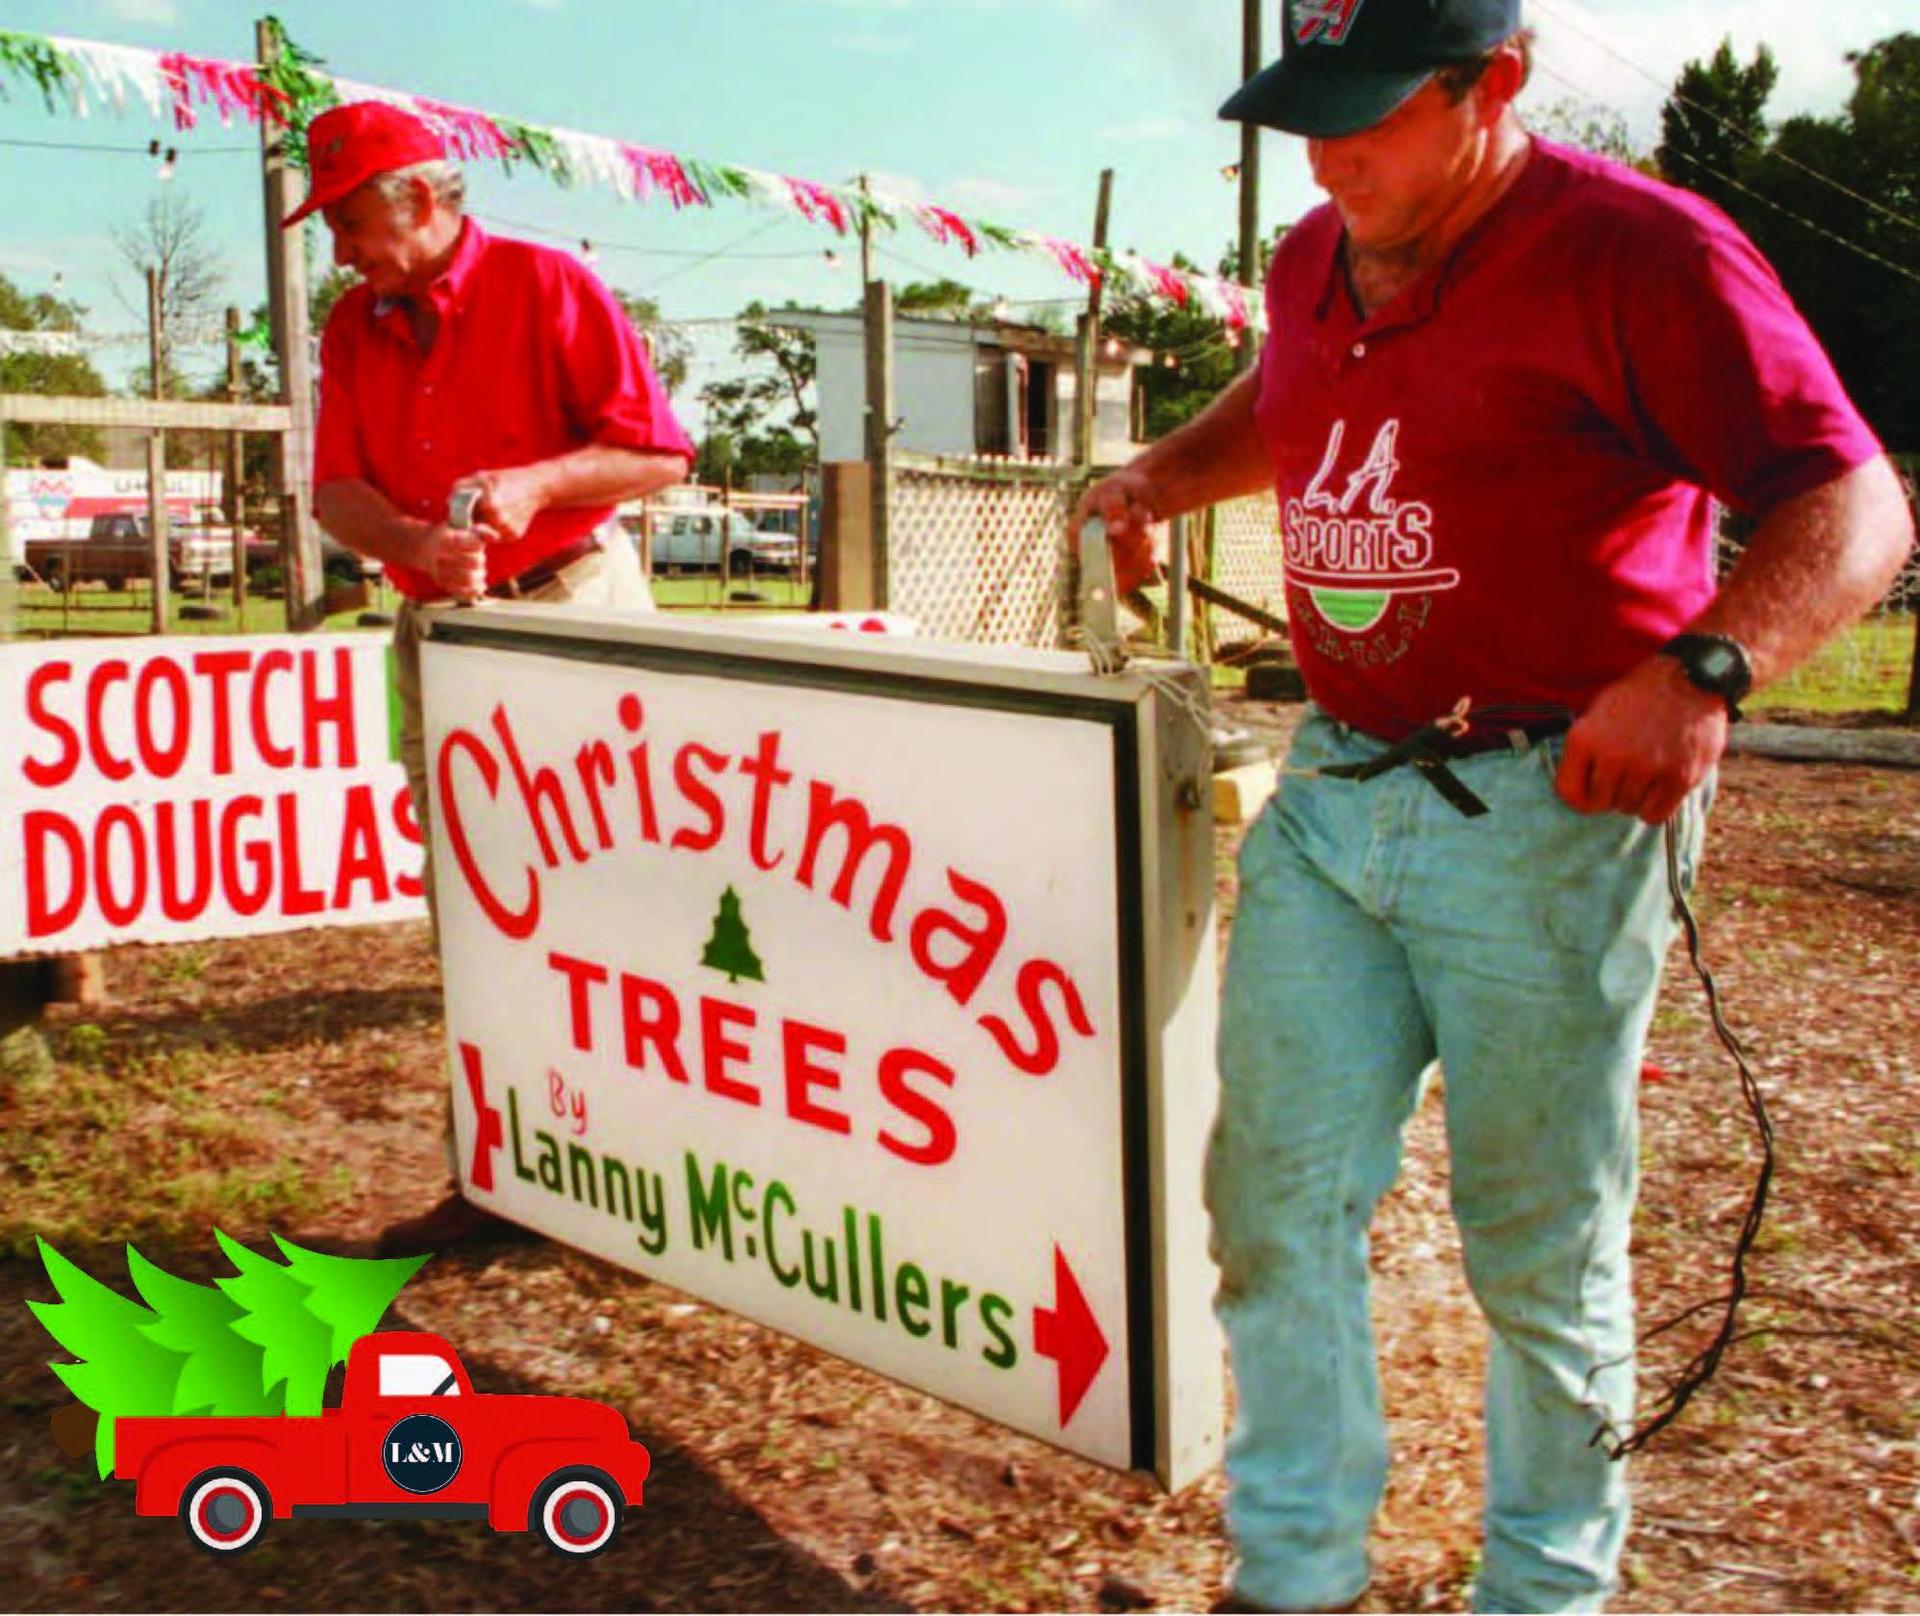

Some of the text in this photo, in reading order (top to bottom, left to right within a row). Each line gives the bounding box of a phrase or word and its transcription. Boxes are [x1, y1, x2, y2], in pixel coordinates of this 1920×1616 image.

[1284, 499, 1433, 570] SPORTS
[1303, 419, 1400, 513] LA
[21, 646, 358, 788] SCOTCH
[22, 785, 427, 938] DOUGLAS
[438, 692, 1096, 1076] Christmas
[547, 1068, 586, 1135] By
[548, 951, 957, 1166] TREES
[507, 1087, 669, 1256] Lanny
